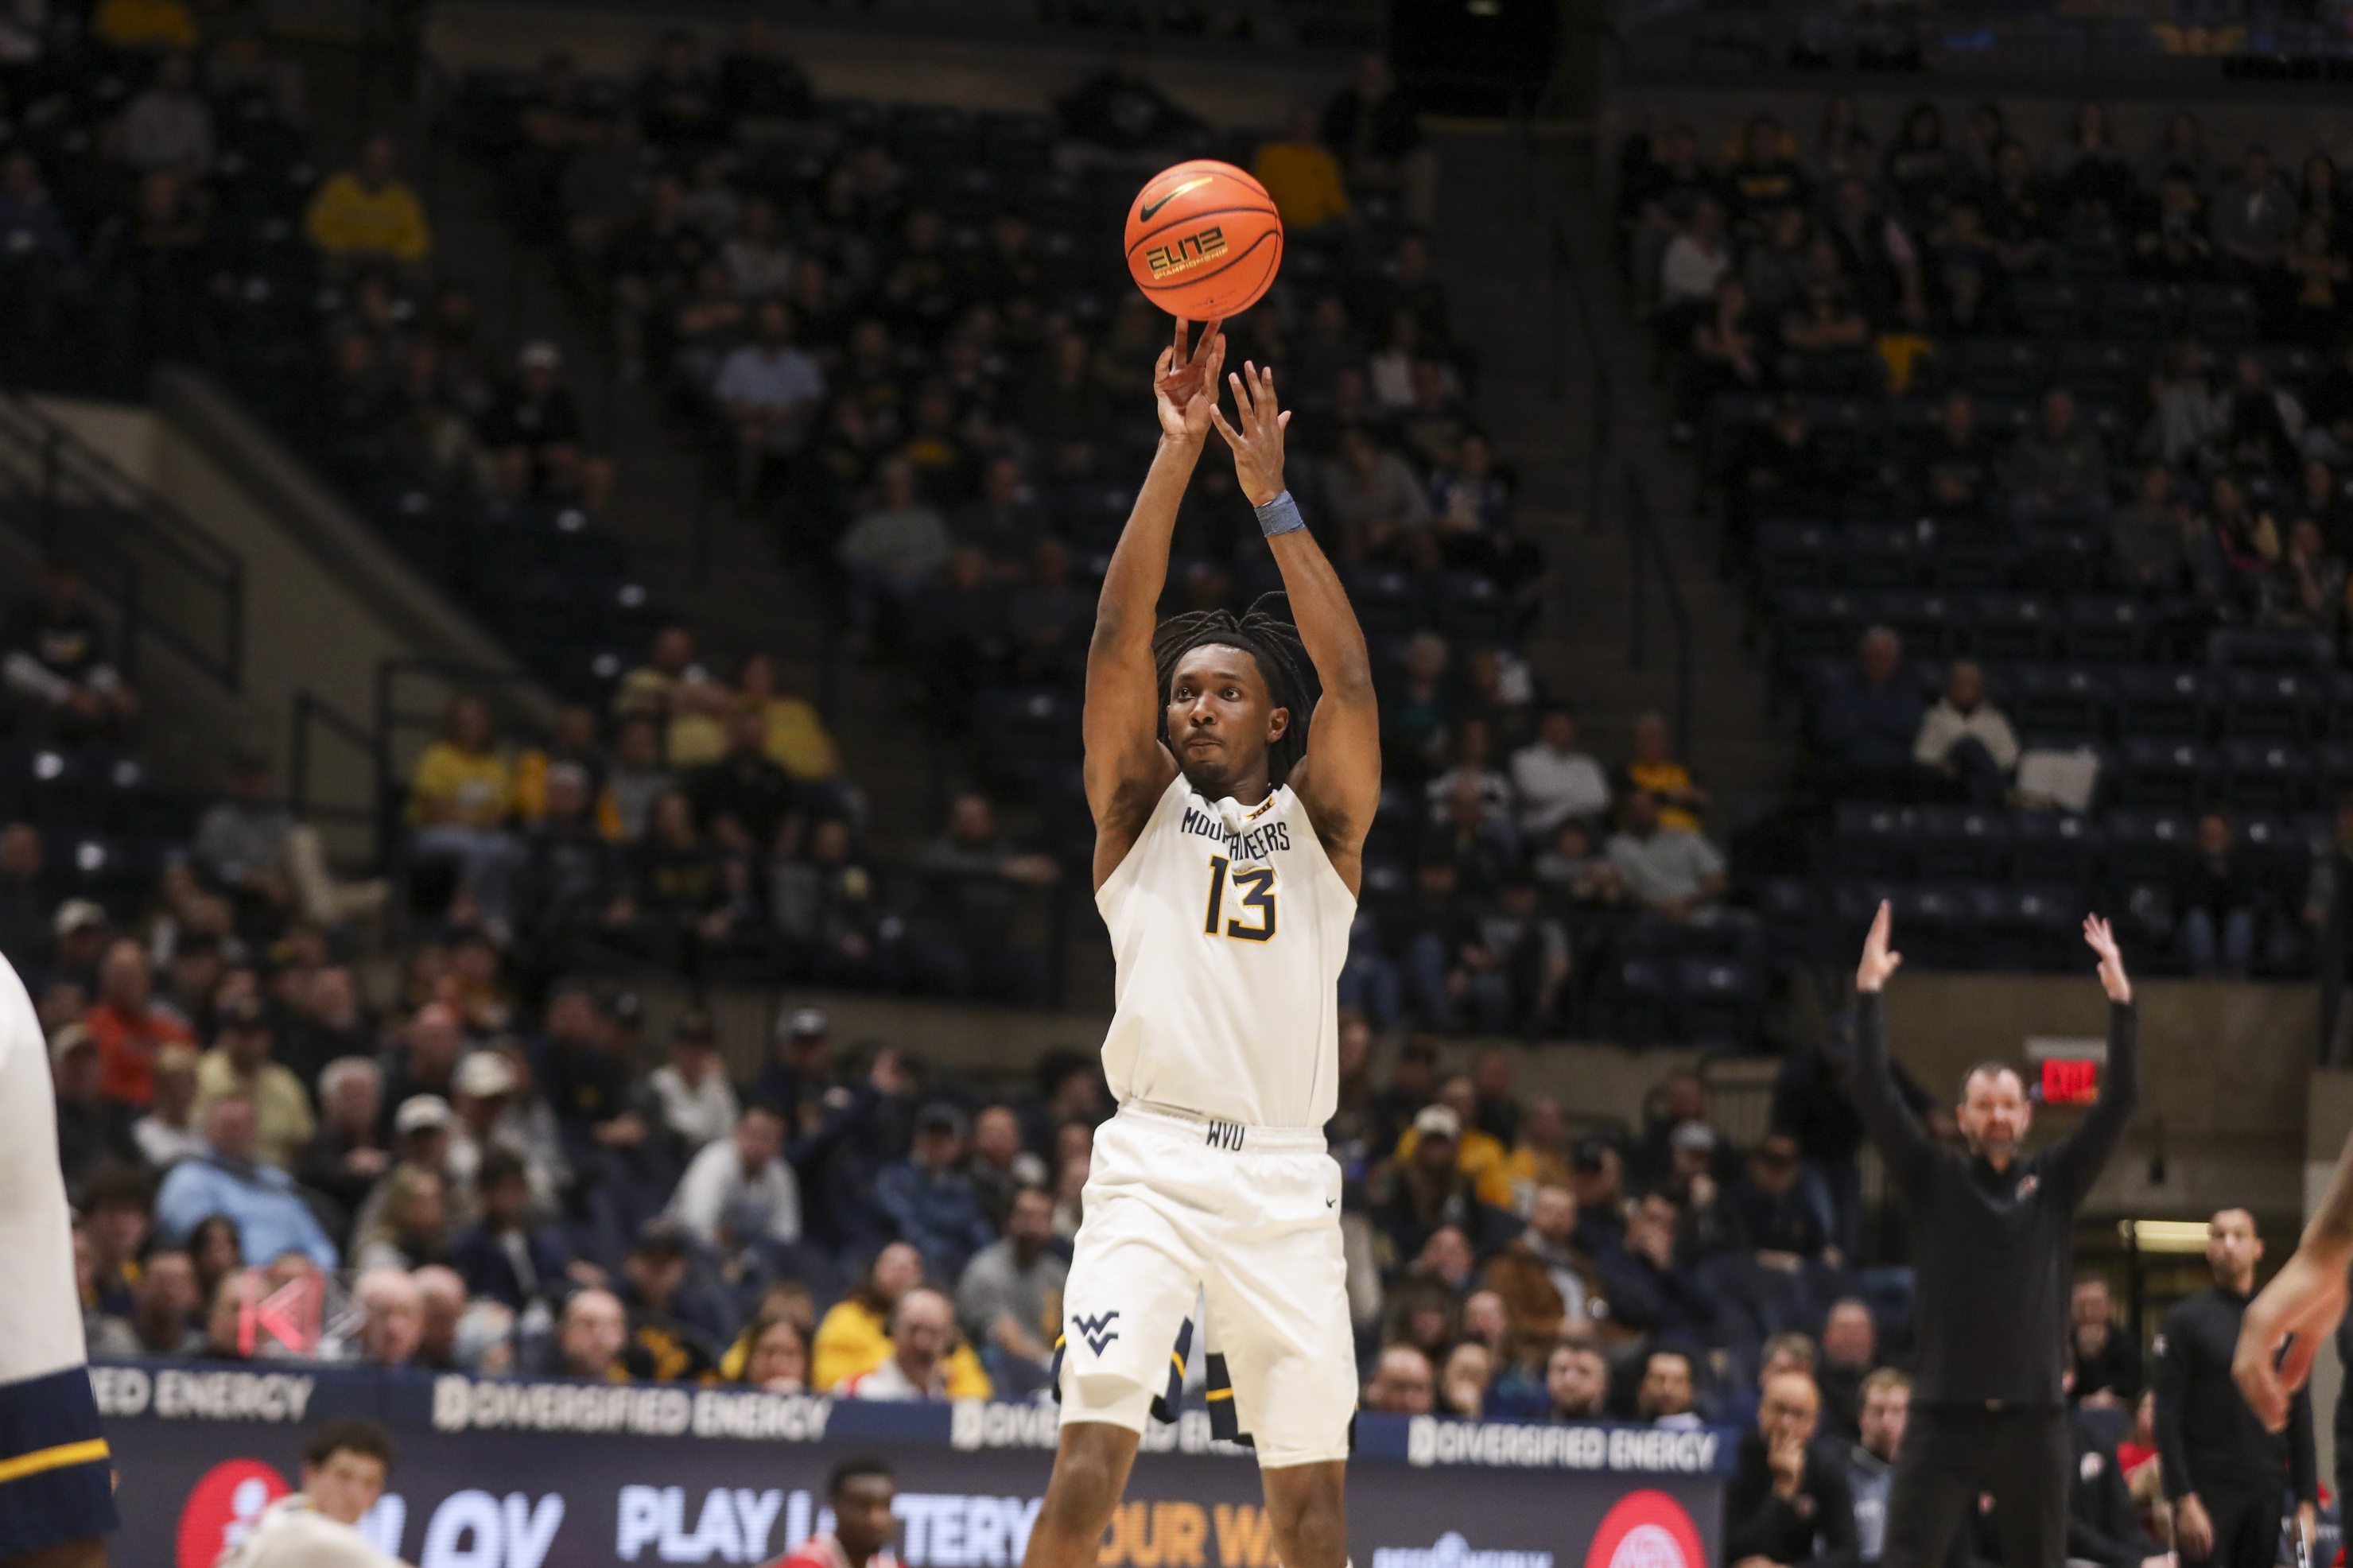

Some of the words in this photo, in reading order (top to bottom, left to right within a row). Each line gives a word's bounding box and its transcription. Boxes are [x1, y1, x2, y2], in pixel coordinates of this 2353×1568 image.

[1146, 226, 1225, 271] ELITE
[1154, 248, 1229, 280] CHAMPIONSHIP
[1203, 853, 1277, 944] 13
[1206, 1119, 1245, 1151] WVU
[154, 1368, 315, 1422] ENERGY
[692, 1391, 833, 1442] ENERGY
[1608, 1428, 1719, 1472] ENERGY
[616, 1485, 783, 1563] PLAY
[784, 1488, 1043, 1568] LTERY
[1098, 1500, 1210, 1568] OUR
